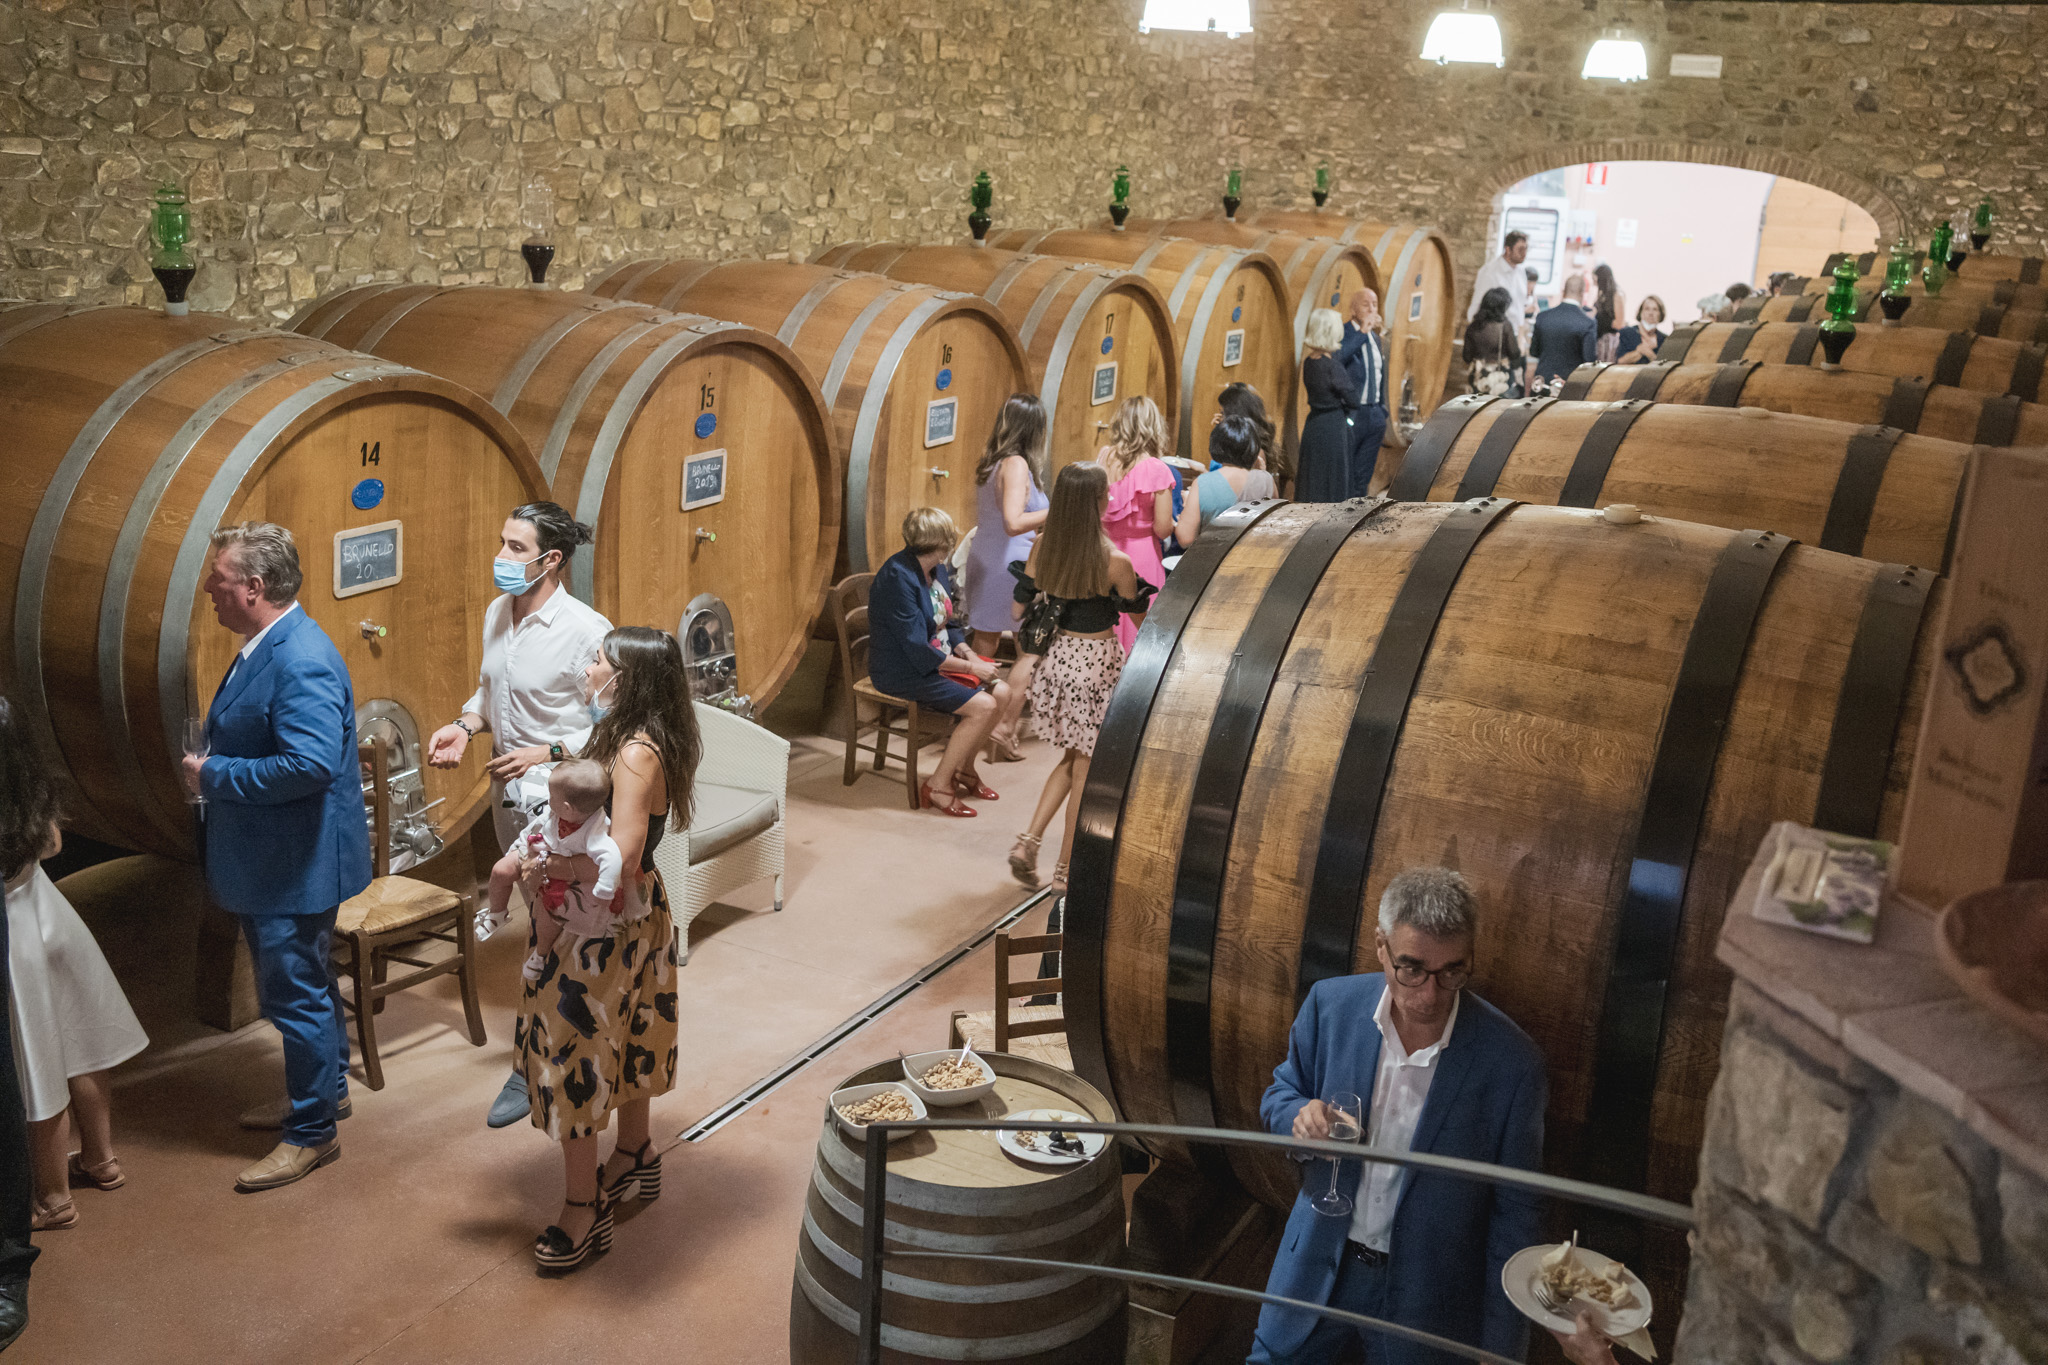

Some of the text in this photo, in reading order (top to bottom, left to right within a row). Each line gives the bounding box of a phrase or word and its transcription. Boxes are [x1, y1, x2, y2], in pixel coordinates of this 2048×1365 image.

[1105, 313, 1115, 334] 17
[942, 343, 952, 366] 16
[700, 383, 715, 411] 15
[360, 441, 381, 467] 14
[342, 542, 394, 563] BRUNELLO
